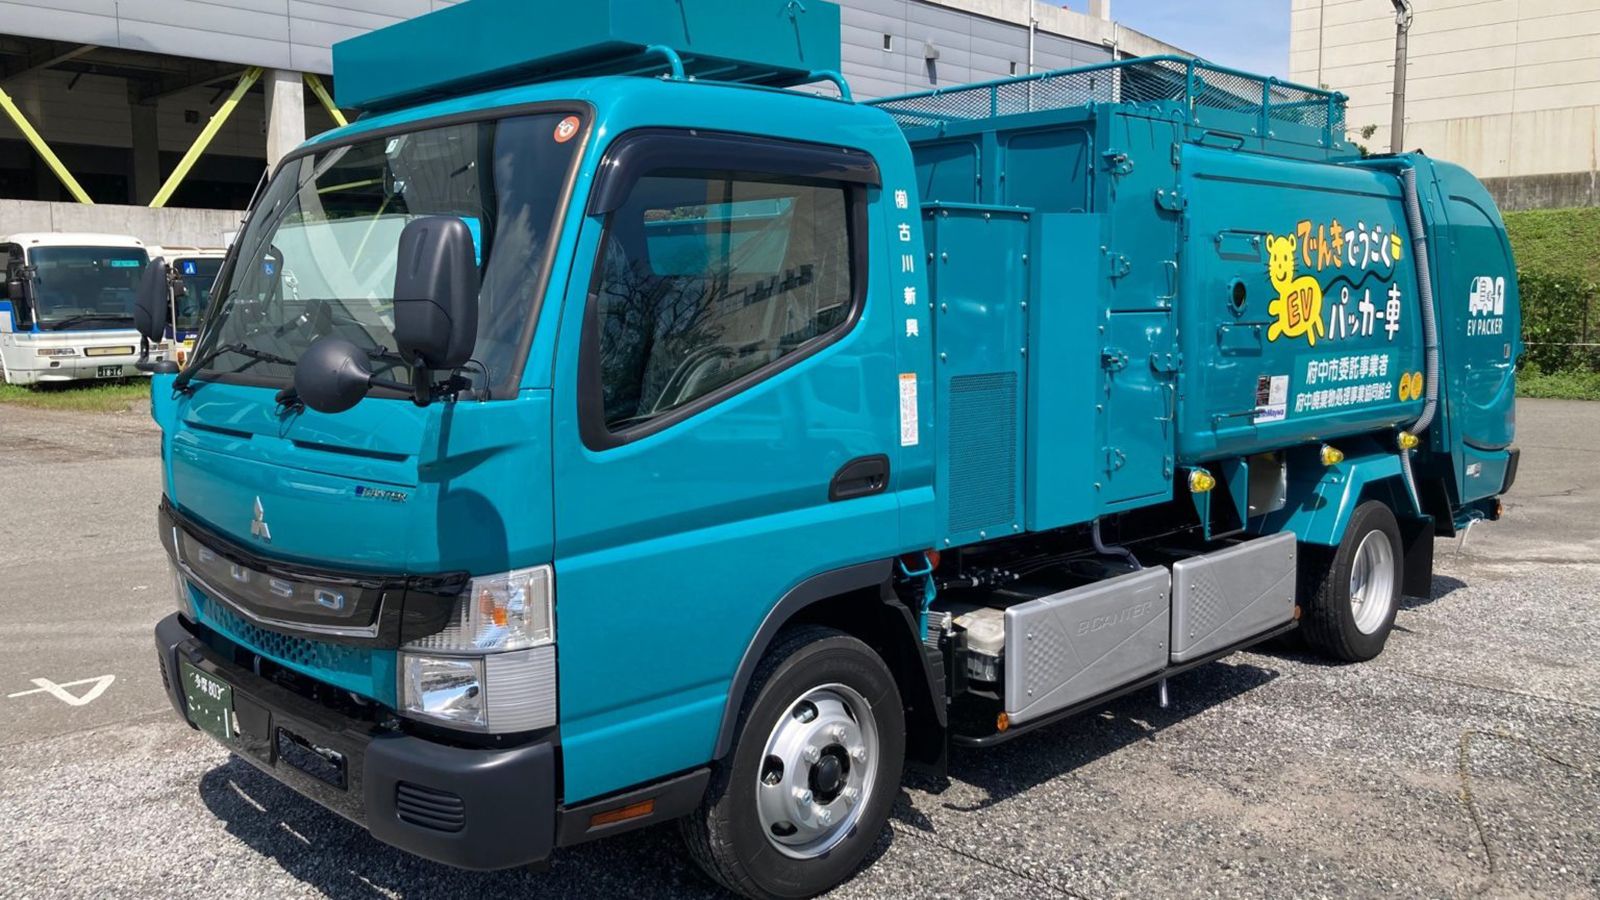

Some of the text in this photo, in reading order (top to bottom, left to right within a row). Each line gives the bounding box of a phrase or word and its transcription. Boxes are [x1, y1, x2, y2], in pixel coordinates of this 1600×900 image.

[1287, 287, 1313, 328] EV
[1328, 282, 1401, 341] パッカー車
[1467, 318, 1503, 337] EV PACKER
[1305, 353, 1389, 385] 府中市委託事業者
[198, 549, 345, 610] FUSO
